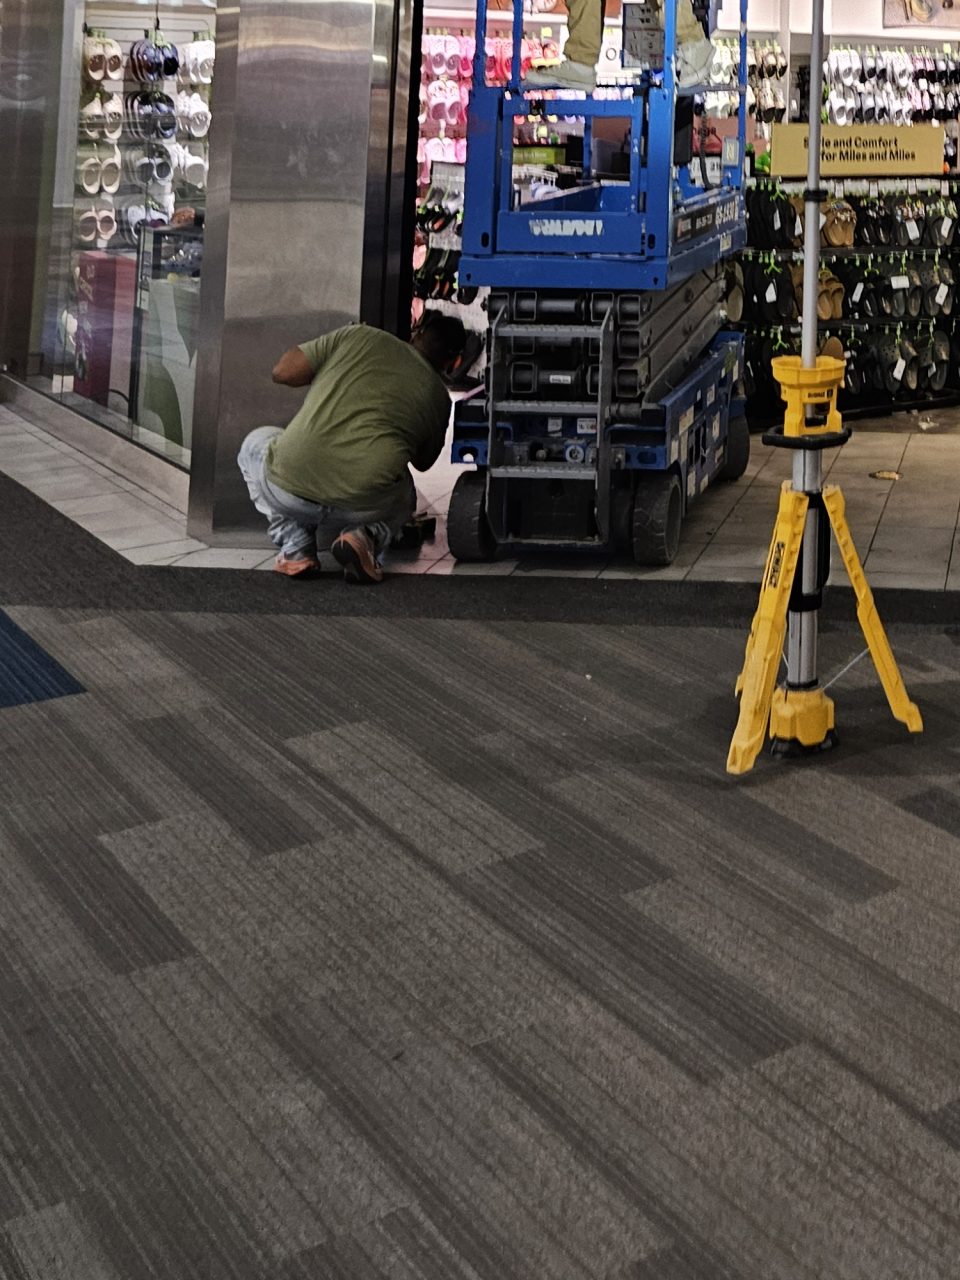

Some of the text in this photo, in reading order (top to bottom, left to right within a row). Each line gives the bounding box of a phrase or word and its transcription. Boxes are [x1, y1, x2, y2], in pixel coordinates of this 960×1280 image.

[803, 136, 898, 149] Sle and Comfort
[820, 150, 916, 162] for Miles and Miles
